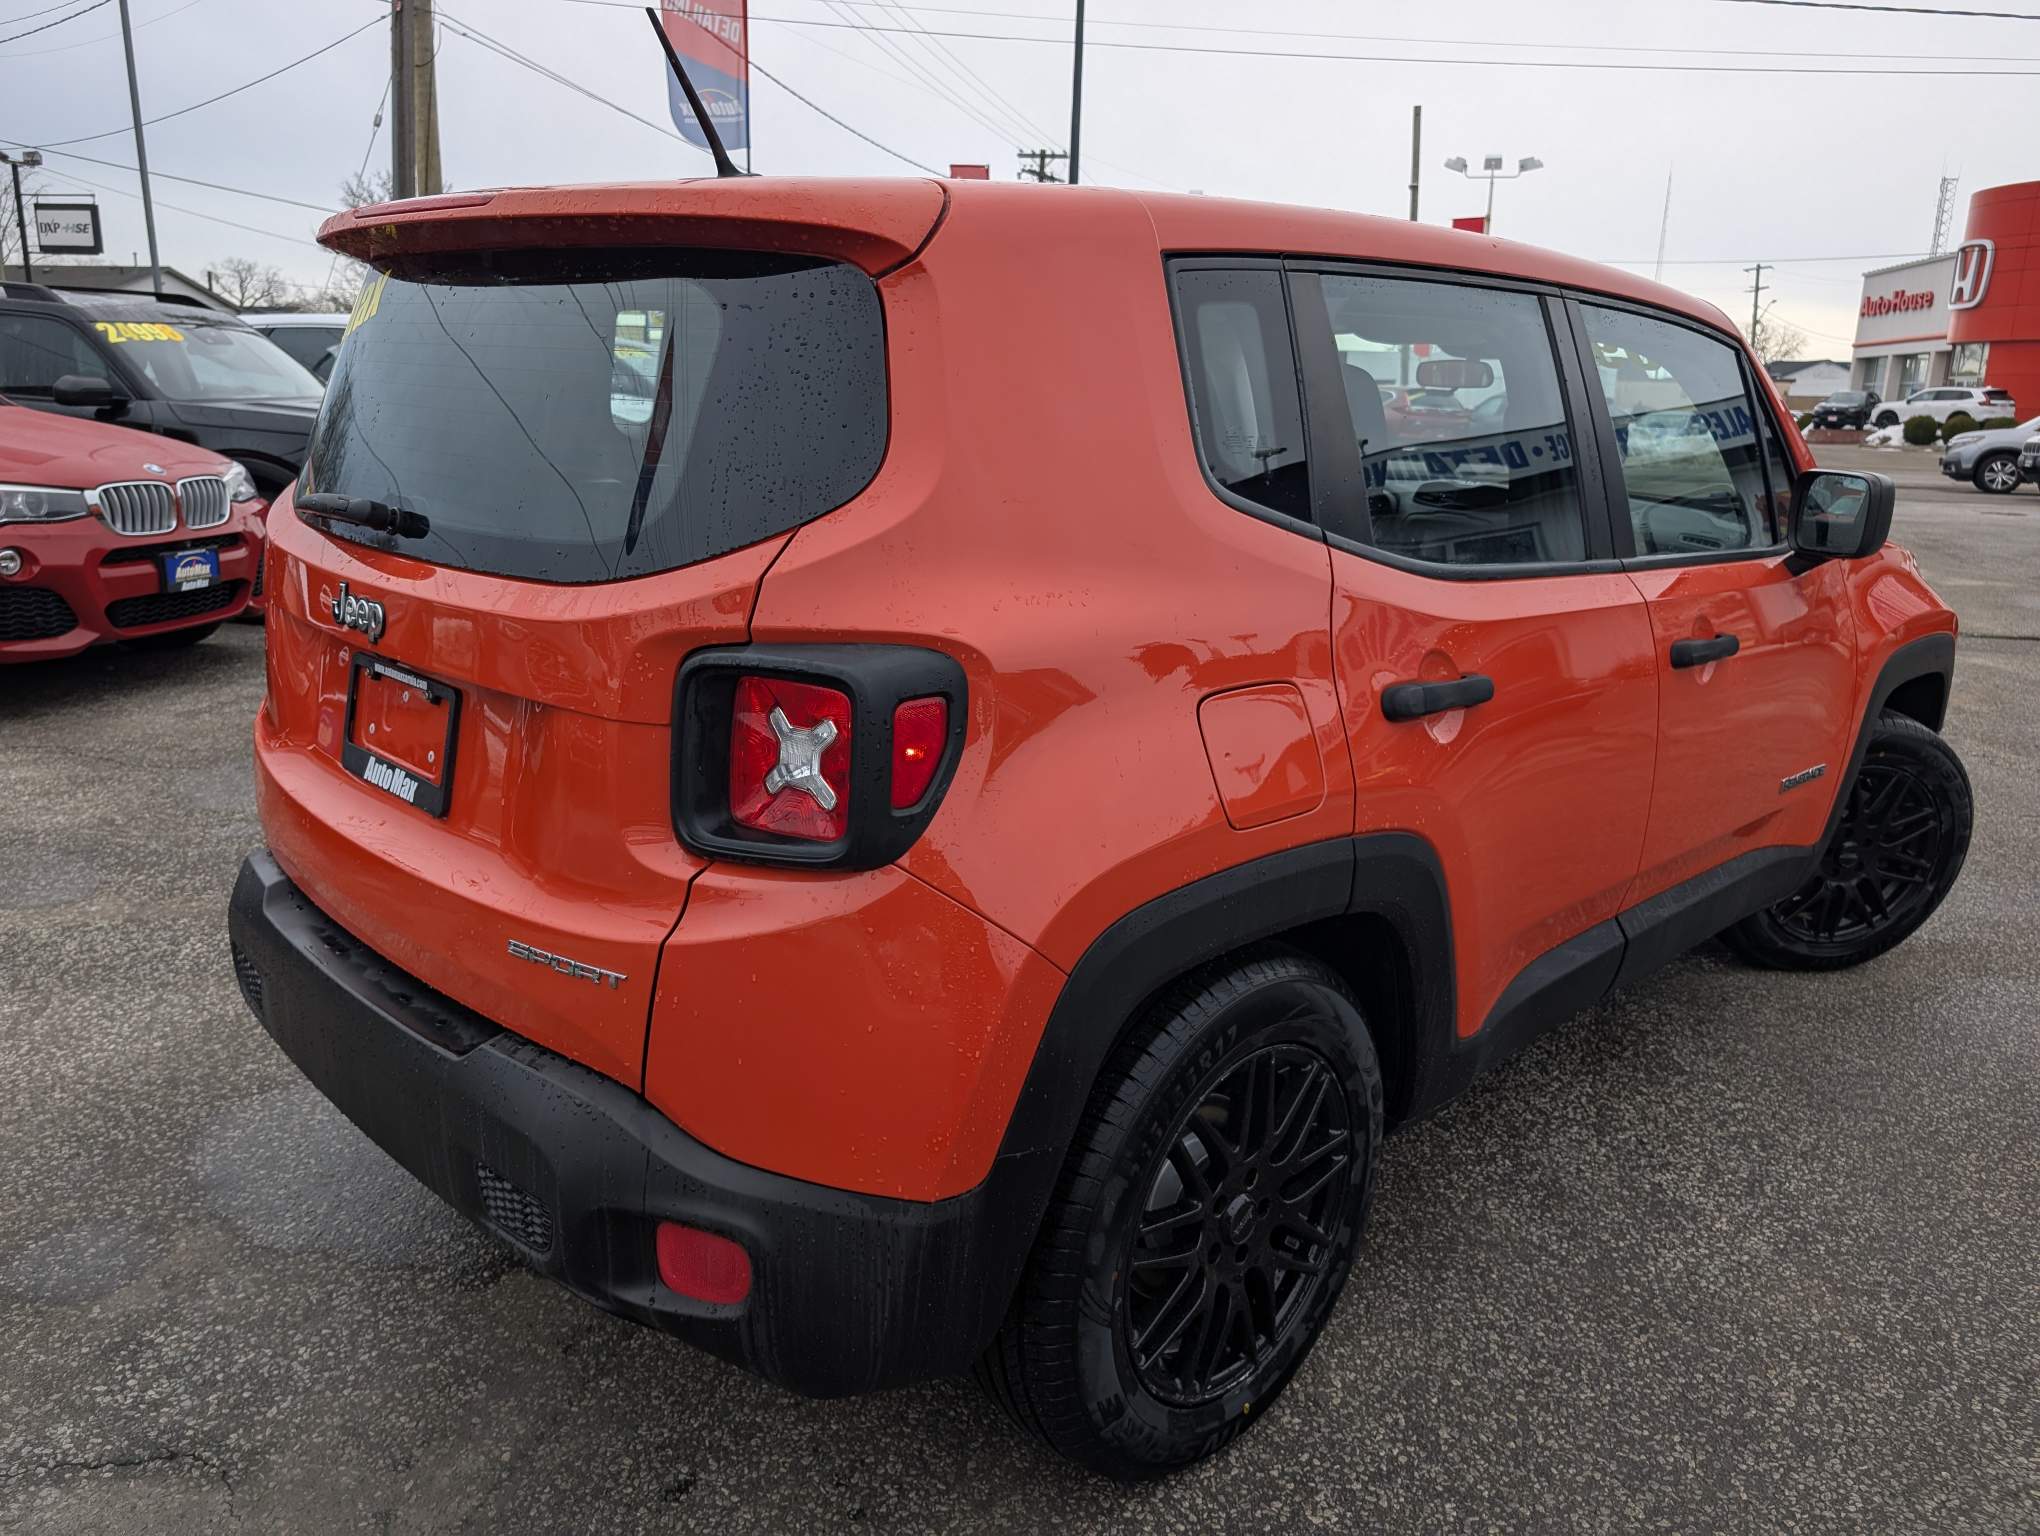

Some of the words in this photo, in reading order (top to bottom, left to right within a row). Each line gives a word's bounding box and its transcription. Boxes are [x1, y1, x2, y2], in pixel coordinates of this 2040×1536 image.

[1861, 296, 1890, 317] Auto
[1891, 289, 1935, 313] House
[331, 580, 387, 645] Jeep
[363, 755, 418, 803] AutoMax
[508, 939, 628, 989] SPORT
